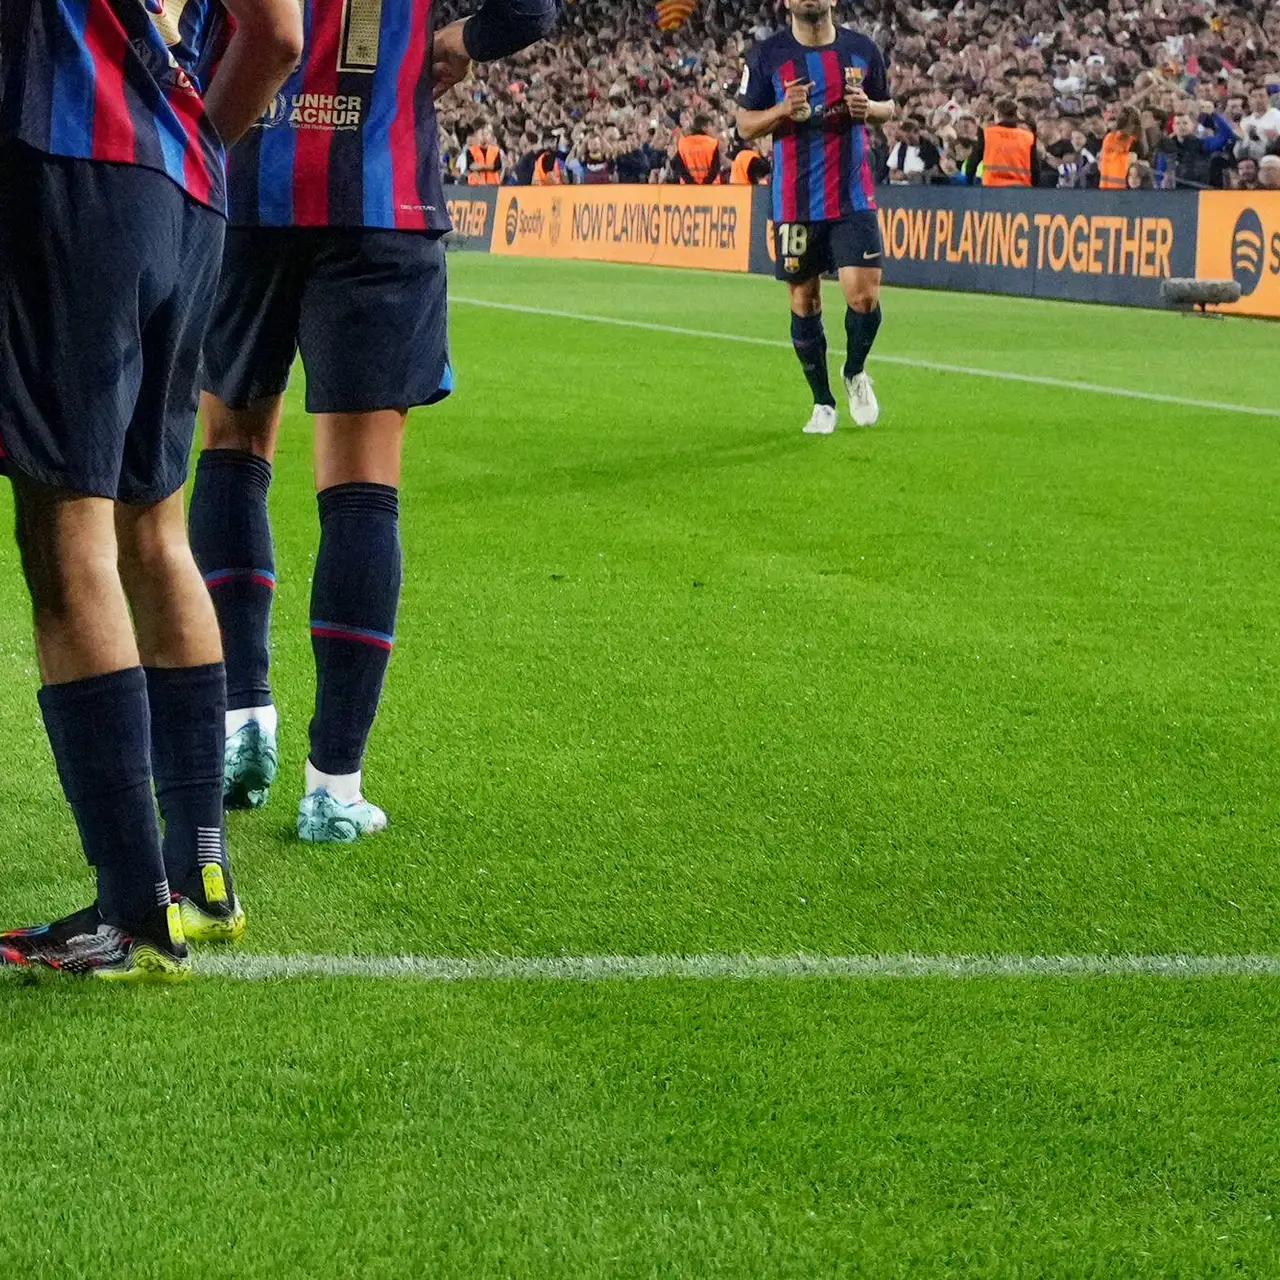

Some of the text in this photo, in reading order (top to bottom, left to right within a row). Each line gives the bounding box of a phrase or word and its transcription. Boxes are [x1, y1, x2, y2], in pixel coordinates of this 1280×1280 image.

[288, 108, 360, 125] ACNUR
[291, 93, 362, 110] UNHCR
[448, 199, 488, 237] GETHER
[518, 202, 737, 250] Spotify NOW PLAYING TOGETHER
[778, 222, 809, 256] 18
[877, 207, 1173, 278] NOW PLAYING TOGETHER
